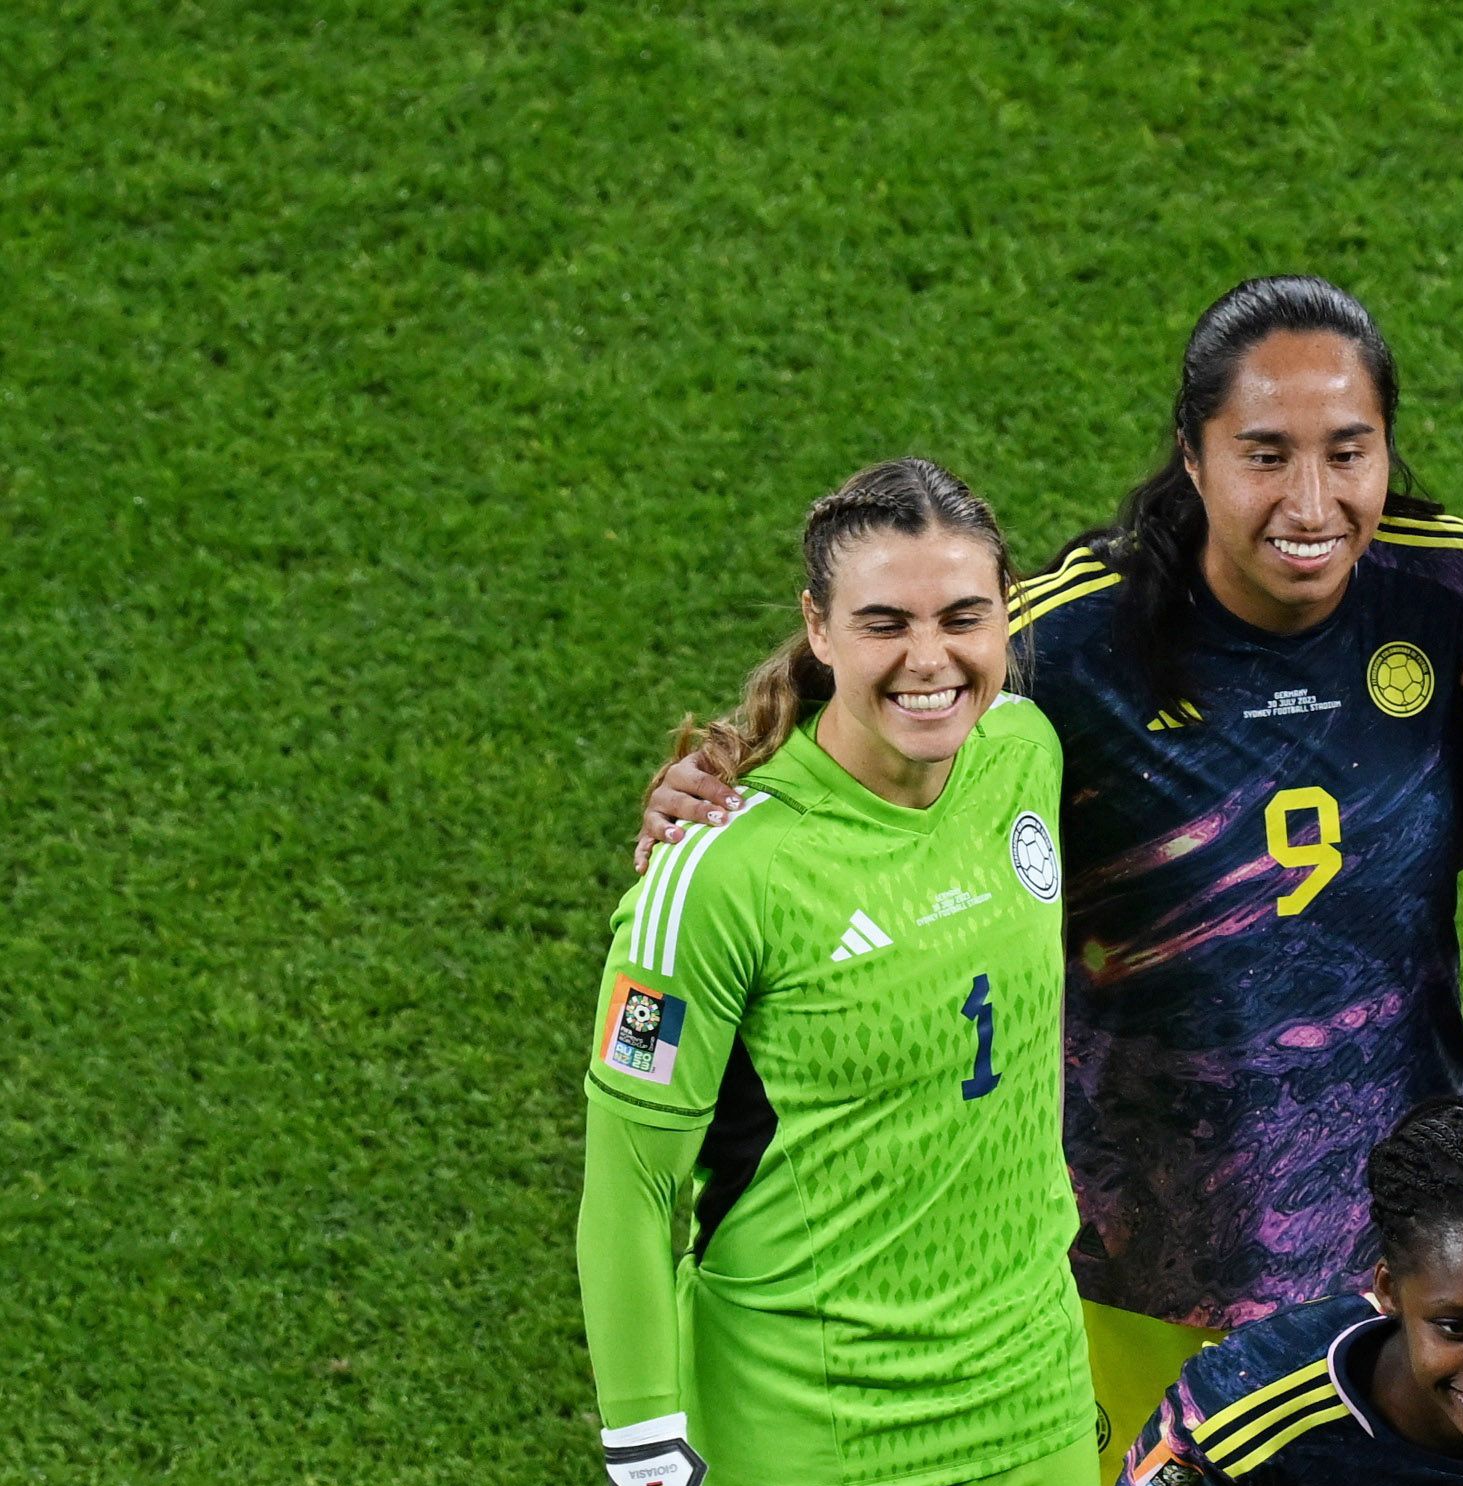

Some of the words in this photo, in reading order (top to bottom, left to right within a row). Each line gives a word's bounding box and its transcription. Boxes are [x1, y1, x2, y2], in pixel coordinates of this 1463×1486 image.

[1274, 689, 1308, 699] GERMANY
[1267, 700, 1277, 708] 30
[1279, 698, 1296, 707] JULY
[1297, 696, 1316, 705] 2023
[1243, 709, 1271, 718] SYDNEY
[1273, 705, 1308, 715] FOOTBALL
[1310, 701, 1341, 711] STADIUM
[1264, 786, 1342, 916] 9
[962, 974, 1002, 1101] 1
[634, 1051, 652, 1062] 20
[632, 1060, 650, 1070] 23
